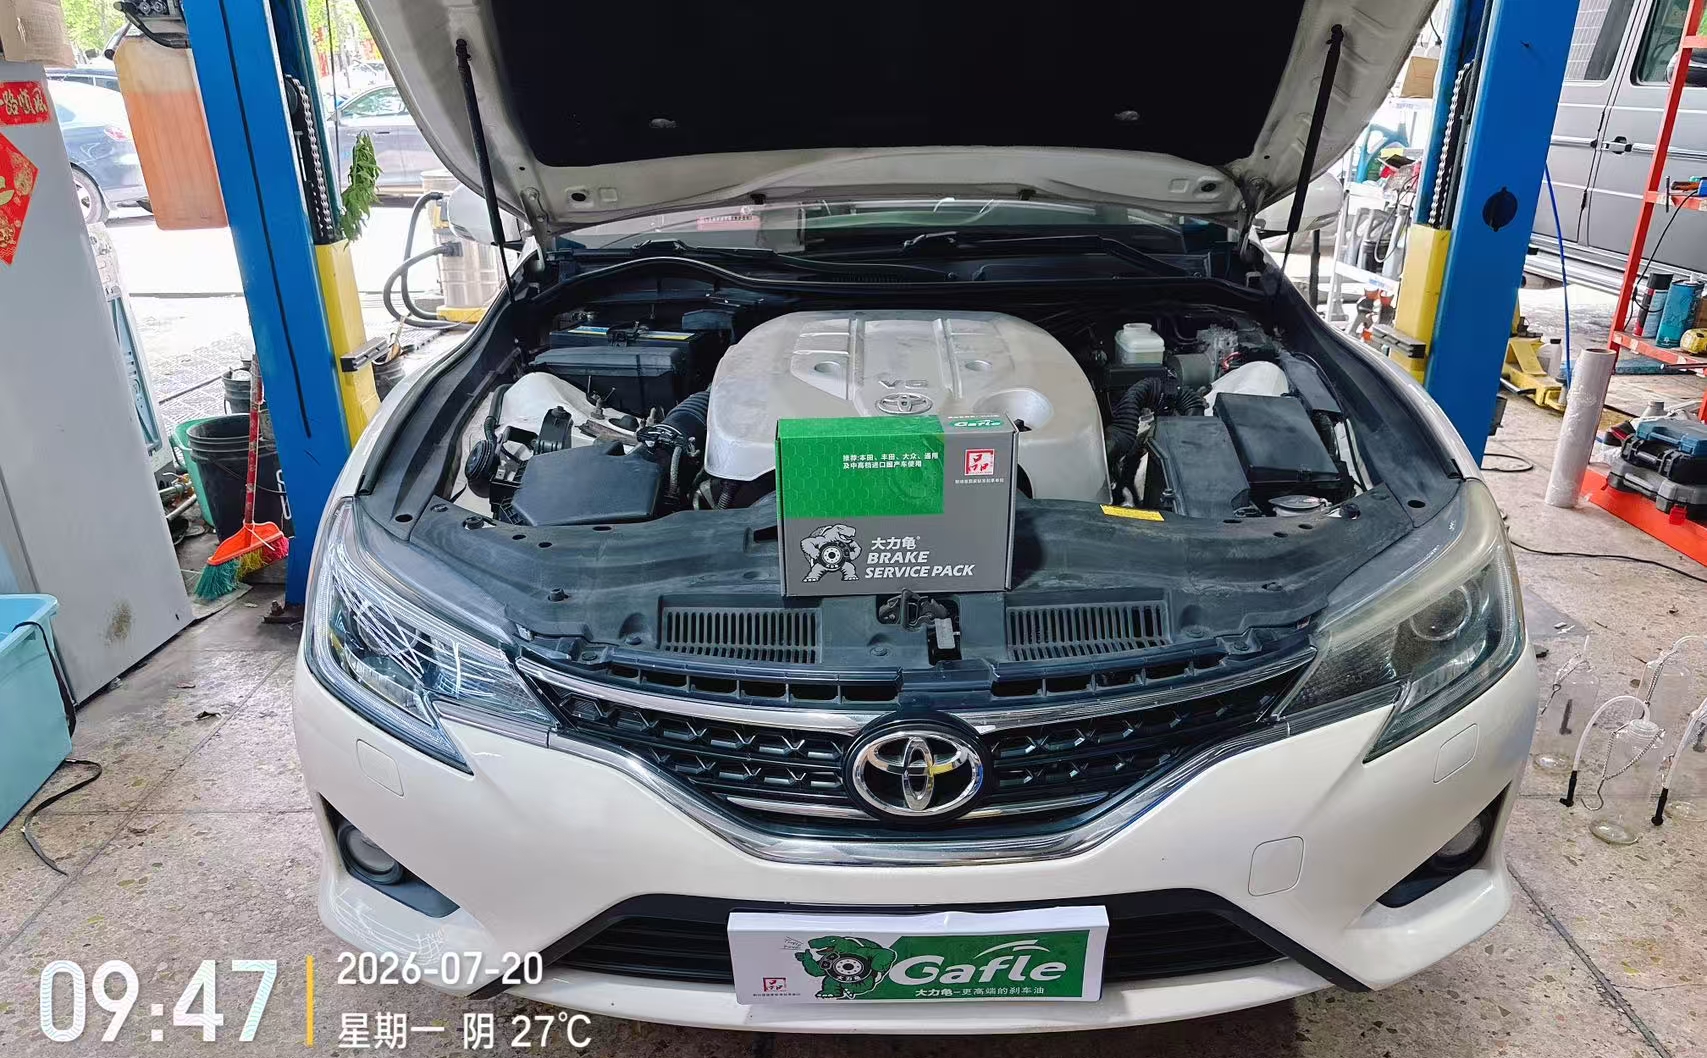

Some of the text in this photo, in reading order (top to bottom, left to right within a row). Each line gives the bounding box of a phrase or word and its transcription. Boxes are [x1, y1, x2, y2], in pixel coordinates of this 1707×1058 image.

[0, 88, 48, 115] 路顺风
[867, 551, 930, 564] BRAKE
[865, 564, 976, 579] SERVICE PACK
[888, 955, 1067, 986] Gafle
